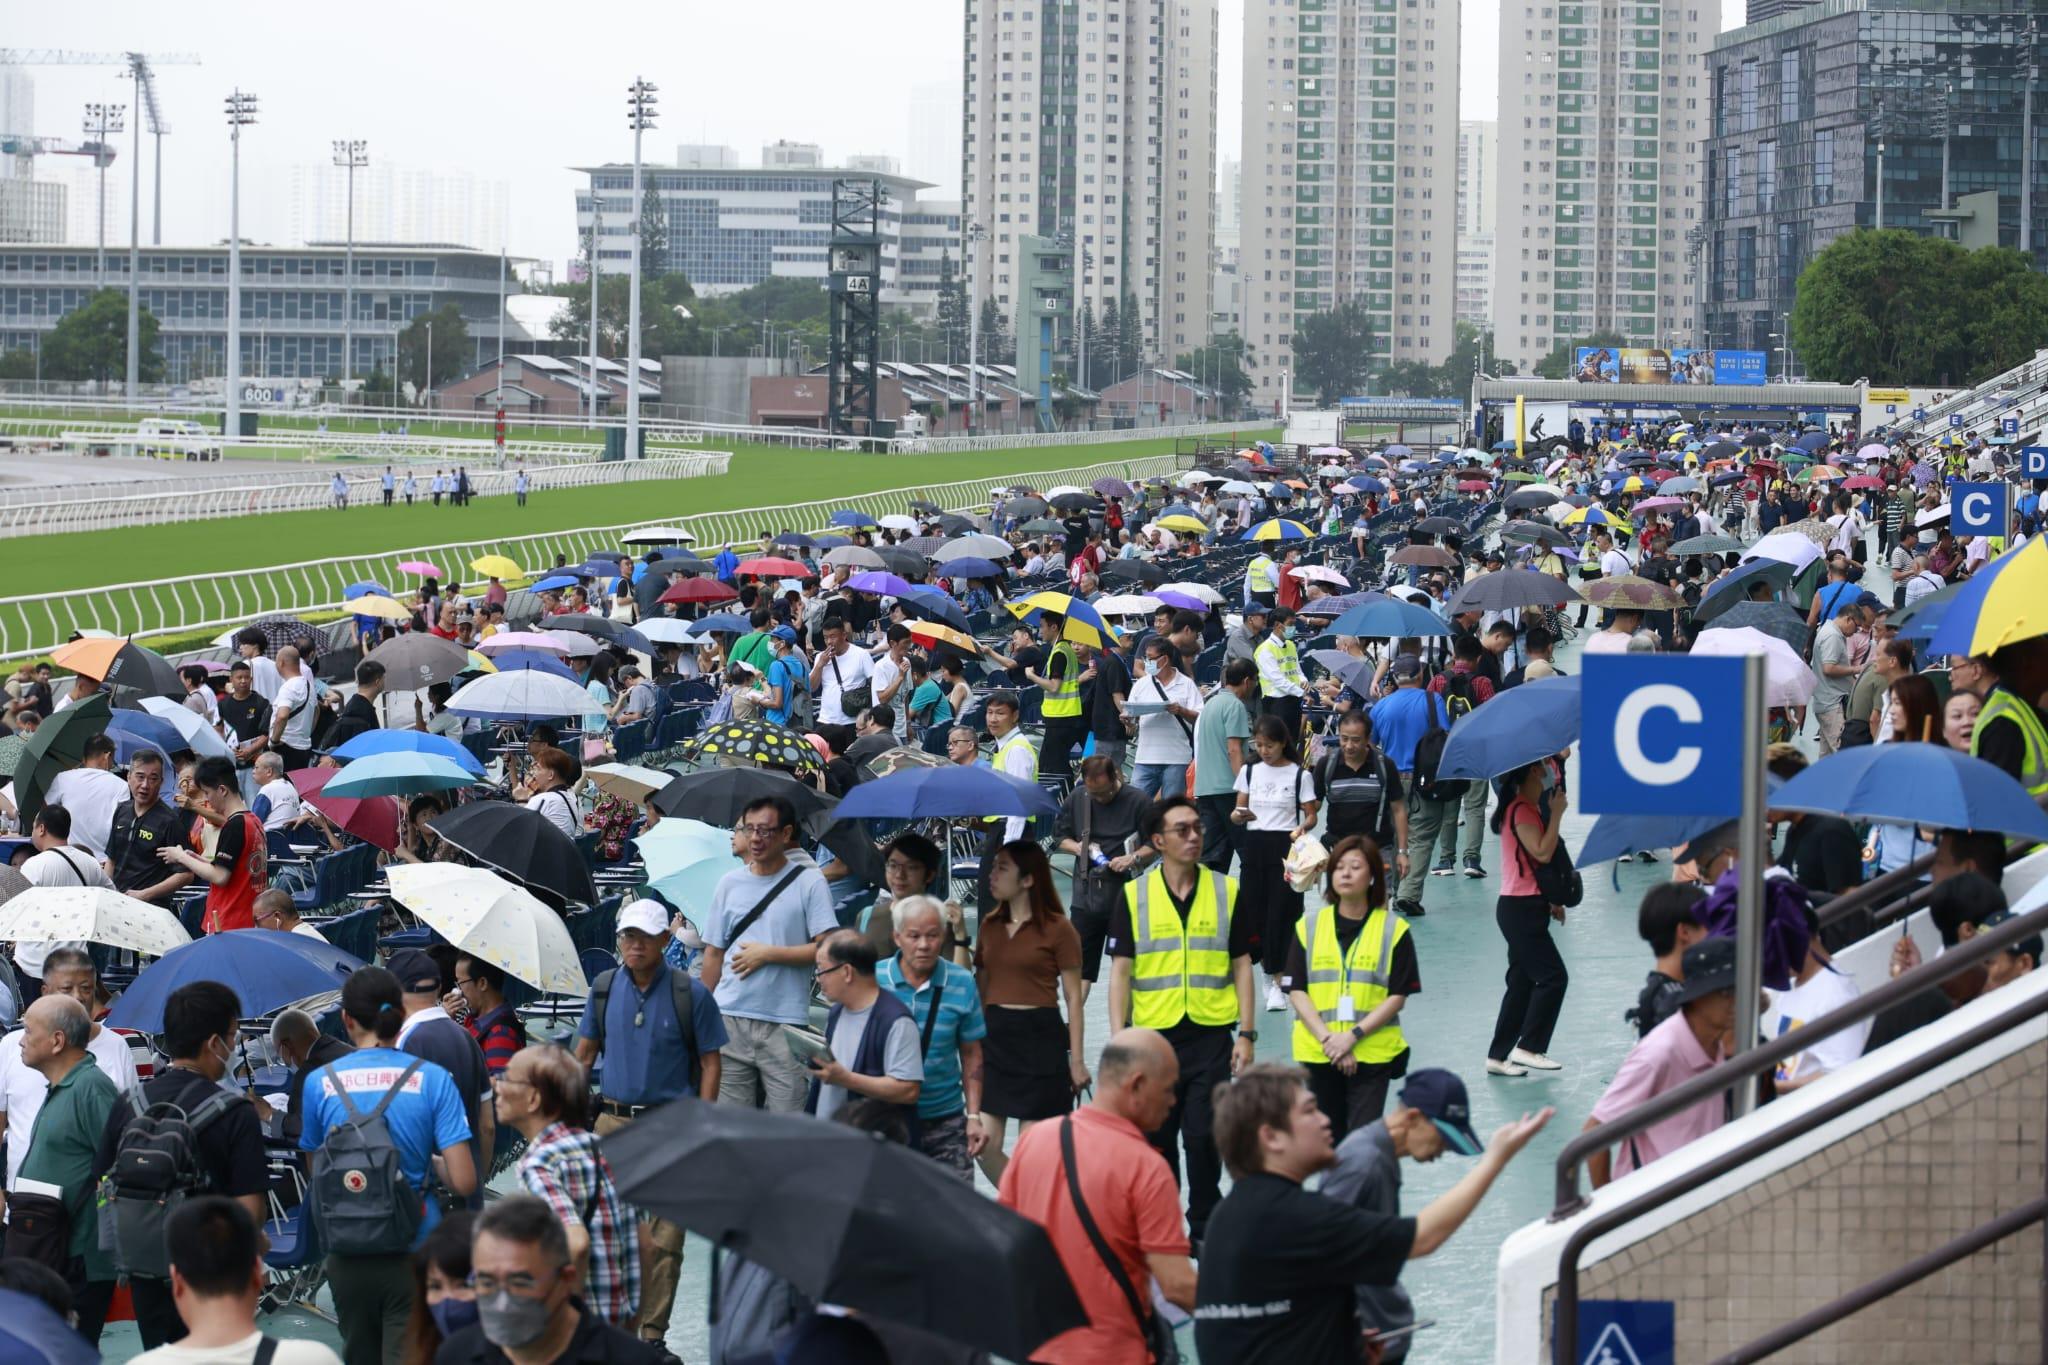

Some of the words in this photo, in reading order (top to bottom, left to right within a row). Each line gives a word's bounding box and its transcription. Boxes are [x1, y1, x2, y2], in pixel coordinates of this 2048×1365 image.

[849, 278, 868, 290] 4A
[1047, 299, 1054, 308] 4
[245, 388, 271, 401] 600
[1952, 416, 1959, 425] E
[2005, 421, 2014, 432] E
[2029, 453, 2046, 473] D
[1962, 492, 1991, 526] C
[1614, 683, 1703, 786] C
[139, 829, 153, 840] T90
